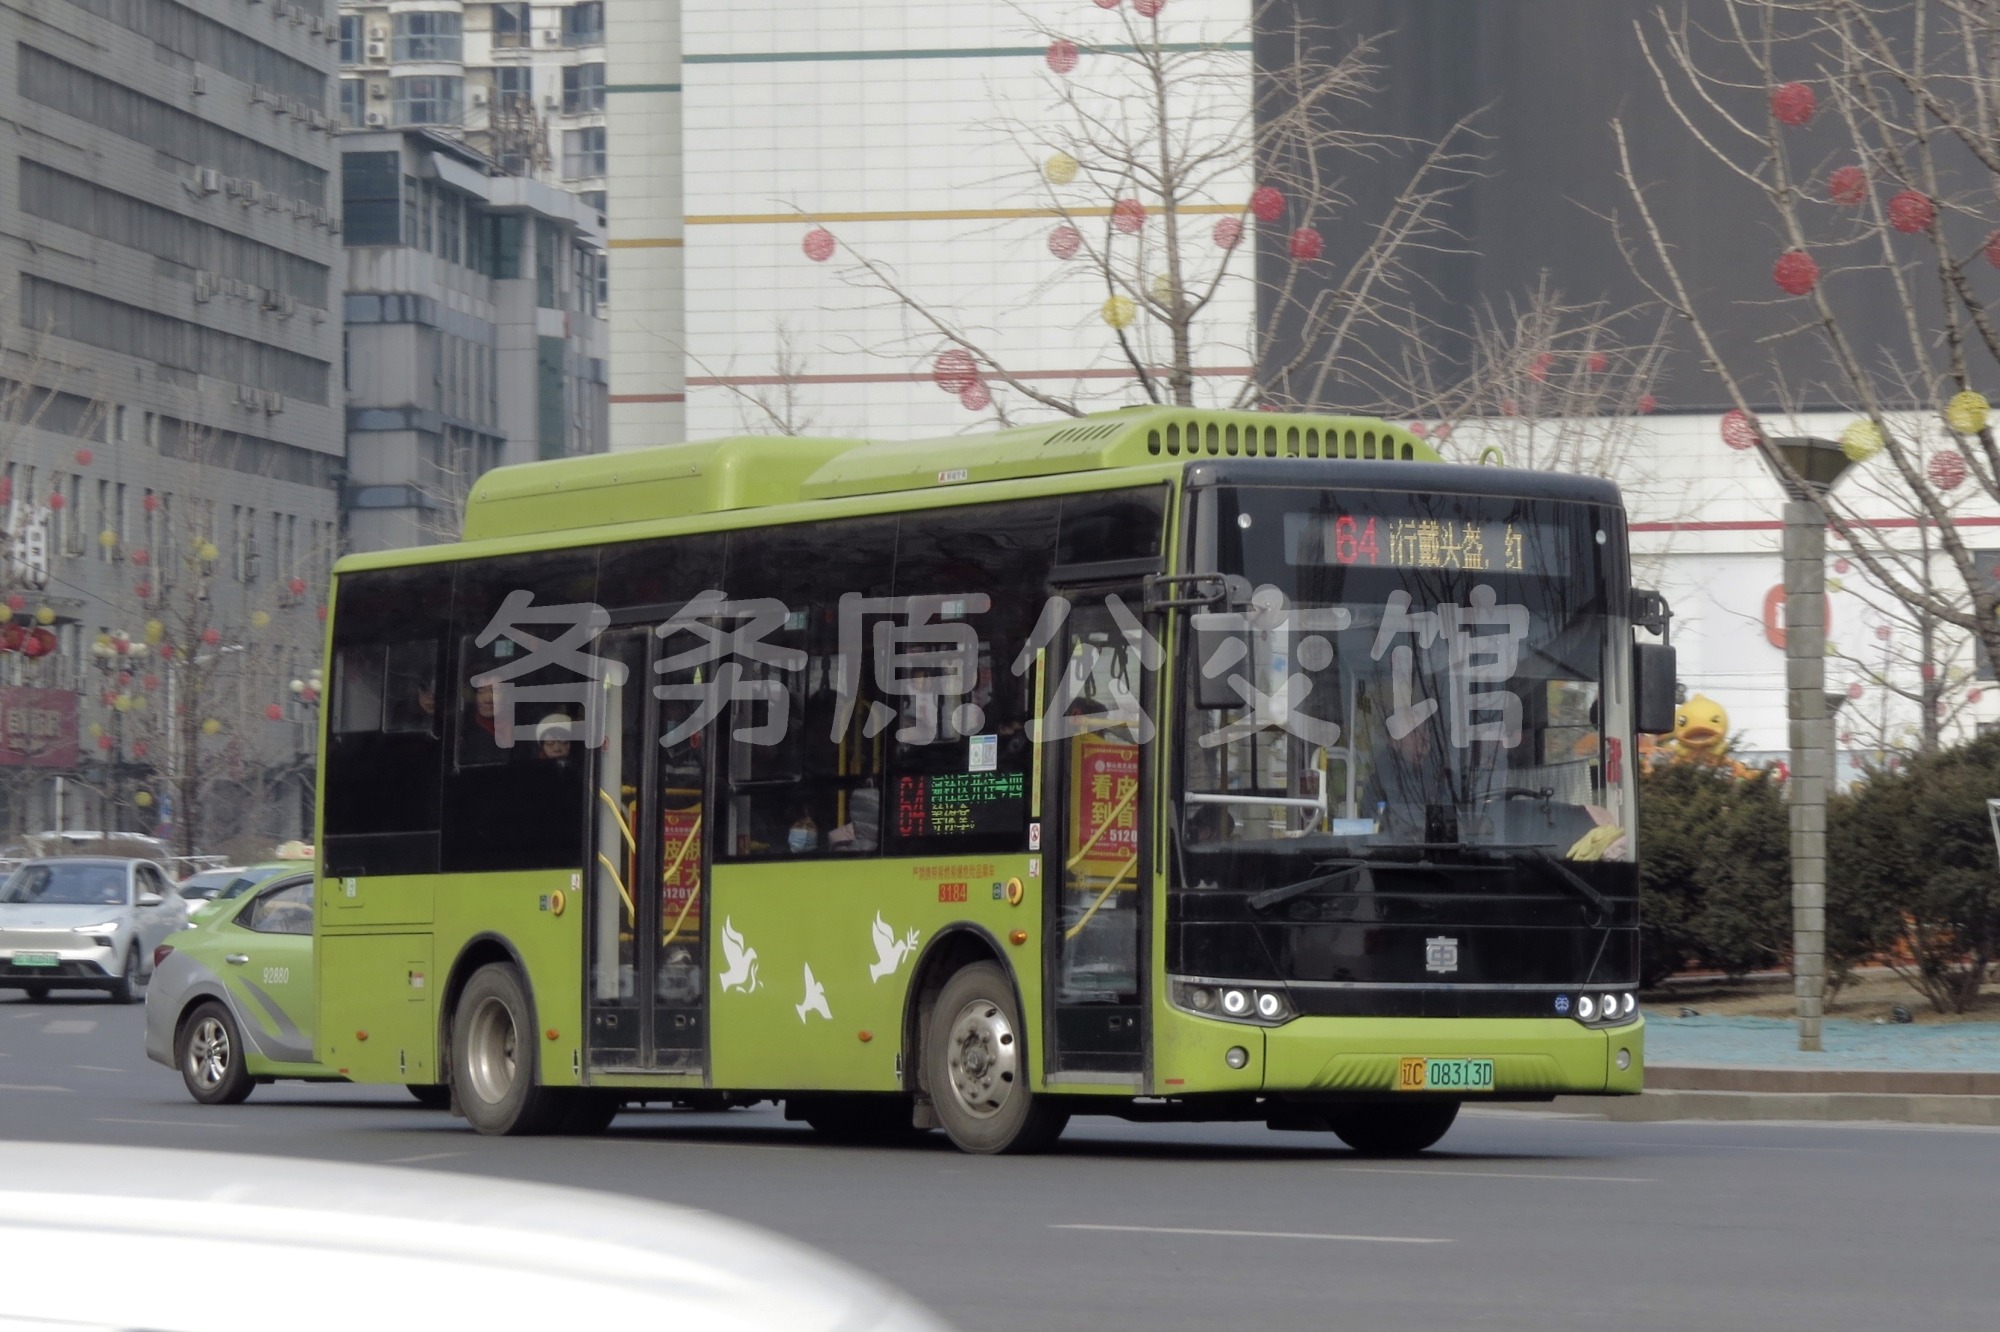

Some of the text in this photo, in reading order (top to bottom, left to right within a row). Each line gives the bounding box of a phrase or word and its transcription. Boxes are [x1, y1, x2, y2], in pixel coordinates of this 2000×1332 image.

[1335, 515, 1379, 564] 64
[940, 884, 966, 900] 3184
[263, 967, 289, 984] 92880
[1431, 1063, 1492, 1085] 08313D
